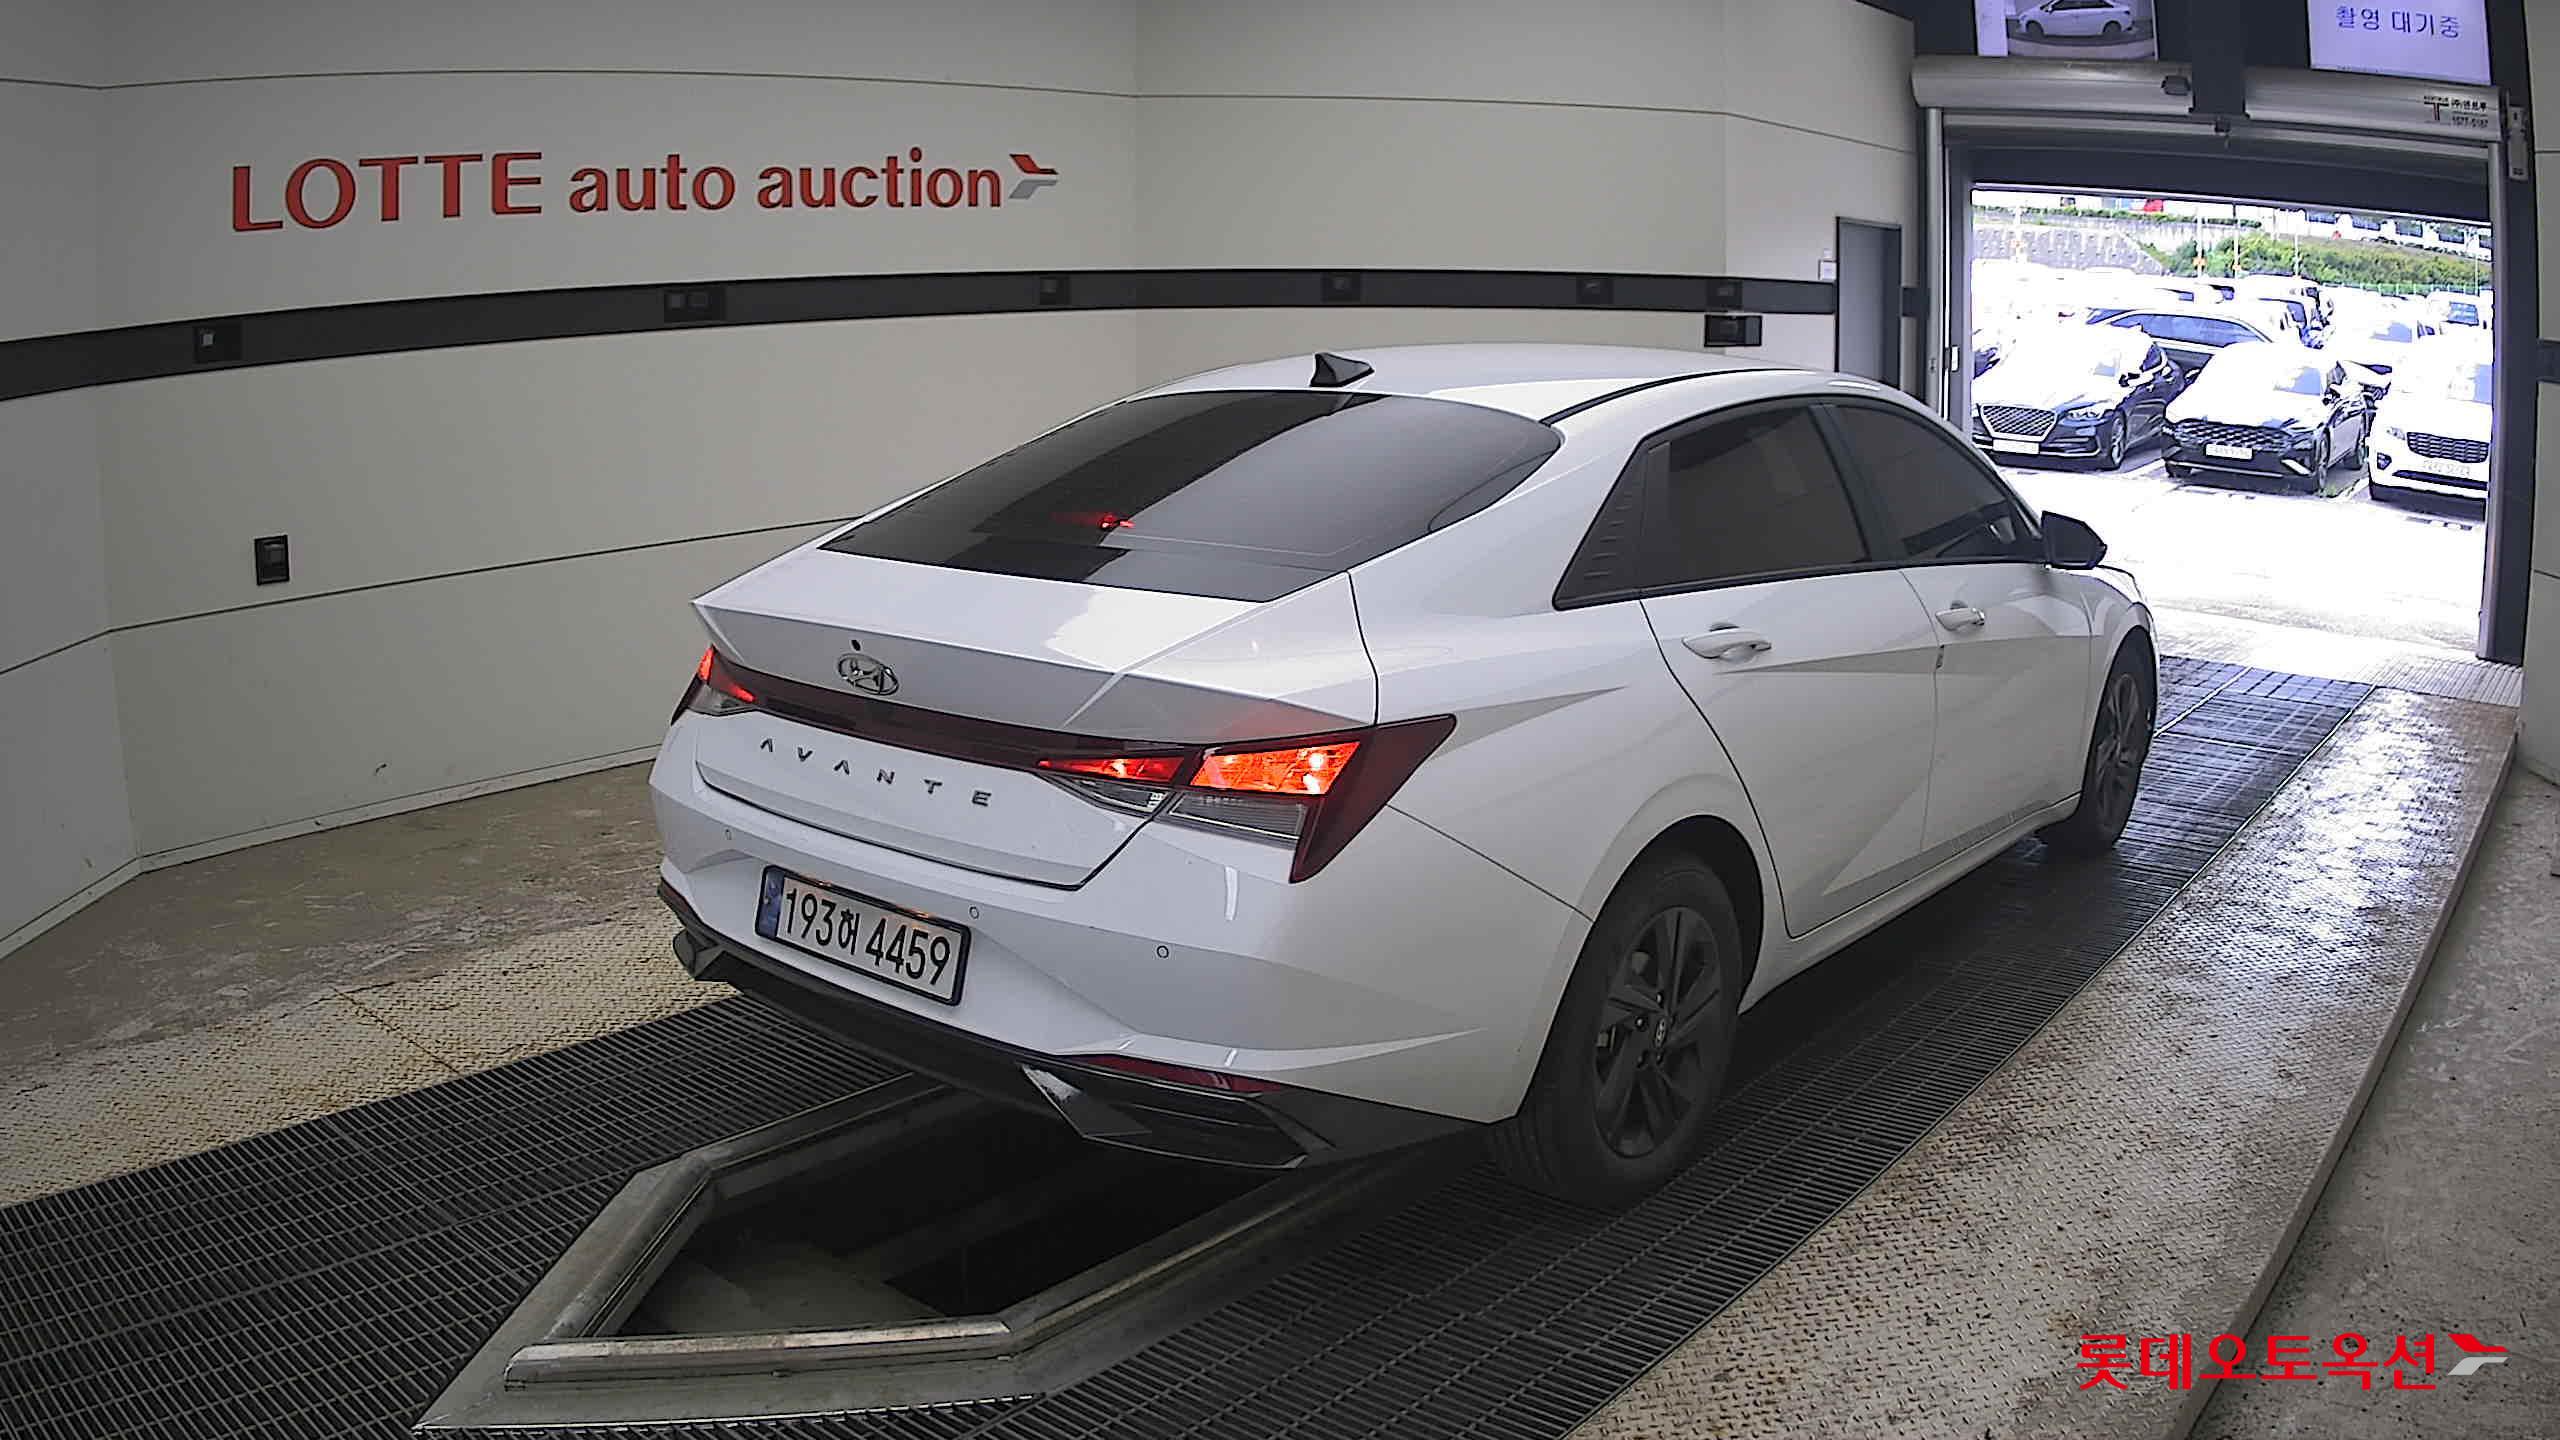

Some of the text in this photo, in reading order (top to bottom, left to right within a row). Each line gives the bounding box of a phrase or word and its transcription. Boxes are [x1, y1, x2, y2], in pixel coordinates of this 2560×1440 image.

[2336, 6, 2460, 38] 촬영 대기중
[233, 147, 1002, 232] LOTTE auto auction
[759, 737, 991, 807] AVANTE
[786, 888, 950, 986] 193허 4459
